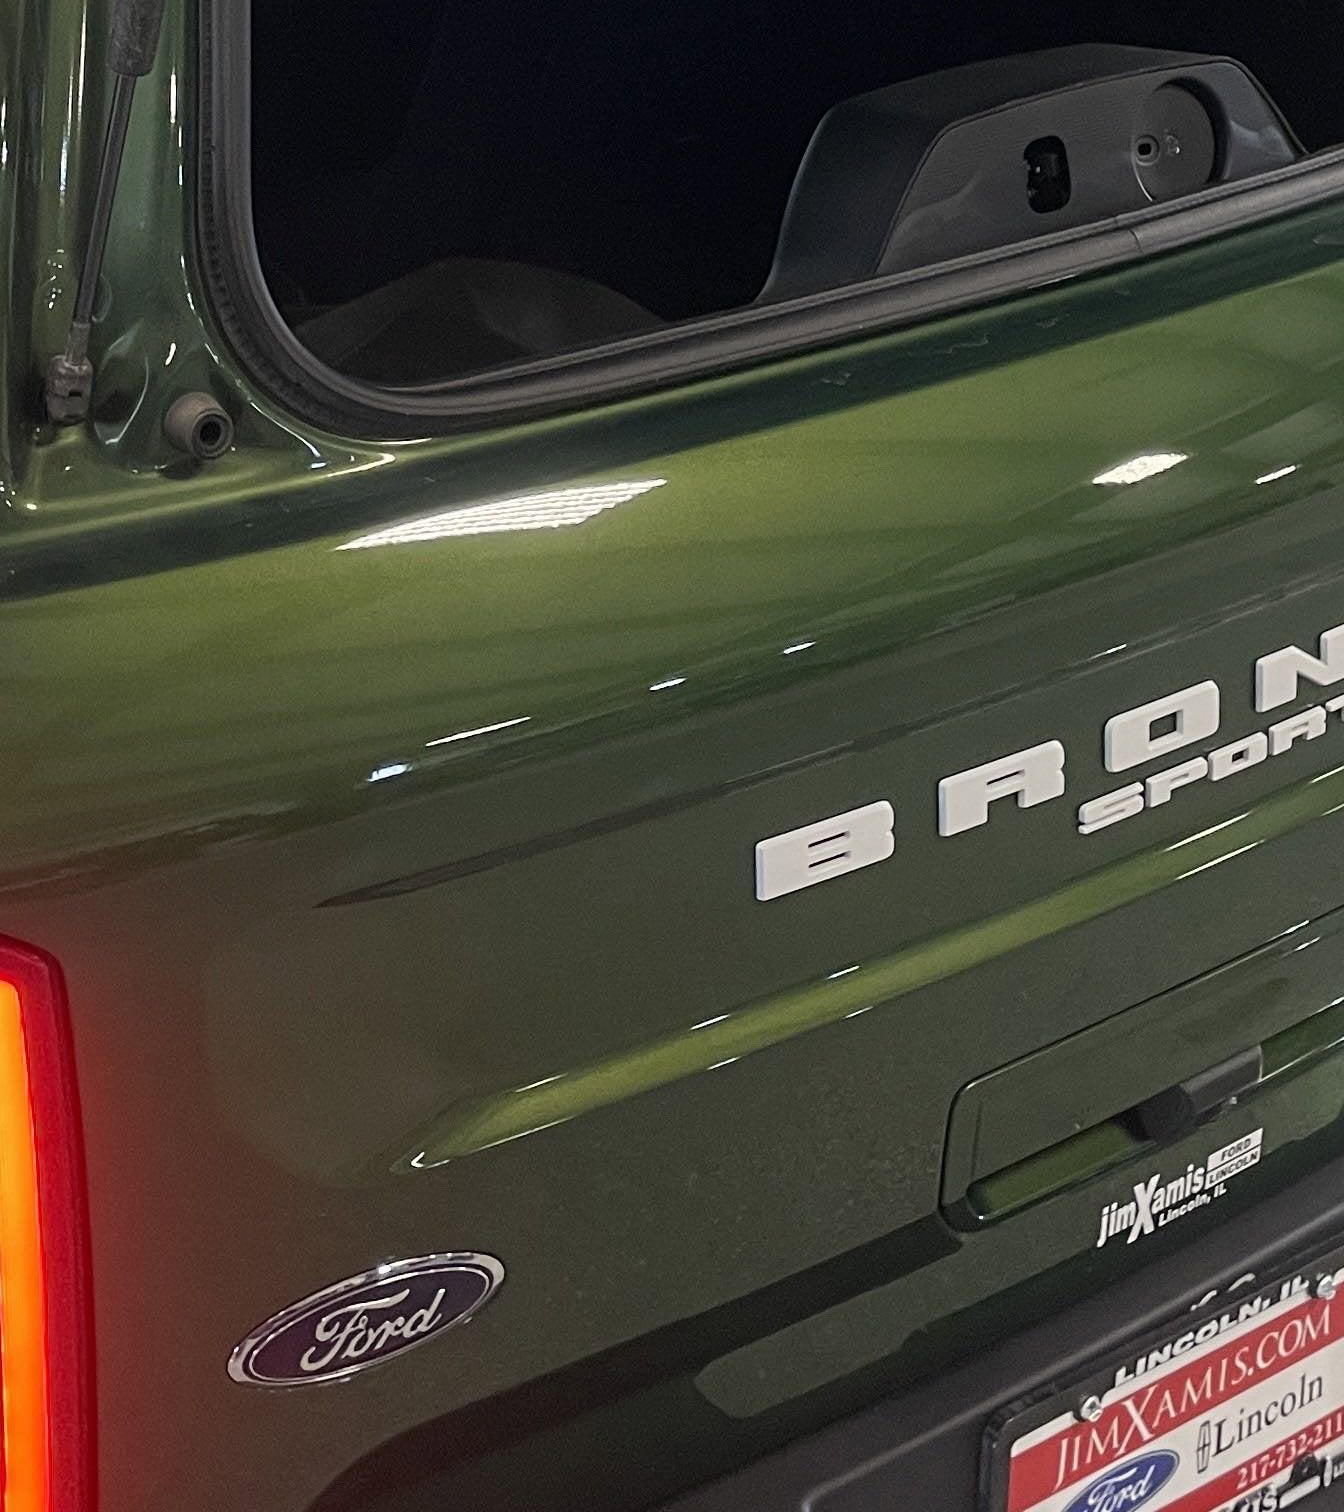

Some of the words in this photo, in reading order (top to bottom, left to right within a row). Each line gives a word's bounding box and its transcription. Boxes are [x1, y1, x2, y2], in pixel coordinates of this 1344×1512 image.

[1220, 1137, 1253, 1162] FORD
[299, 1287, 447, 1372] Ford
[1114, 1295, 1272, 1388] LINCOLN,
[1212, 1373, 1324, 1457] Lincoln
[1080, 1463, 1157, 1512] Ford
